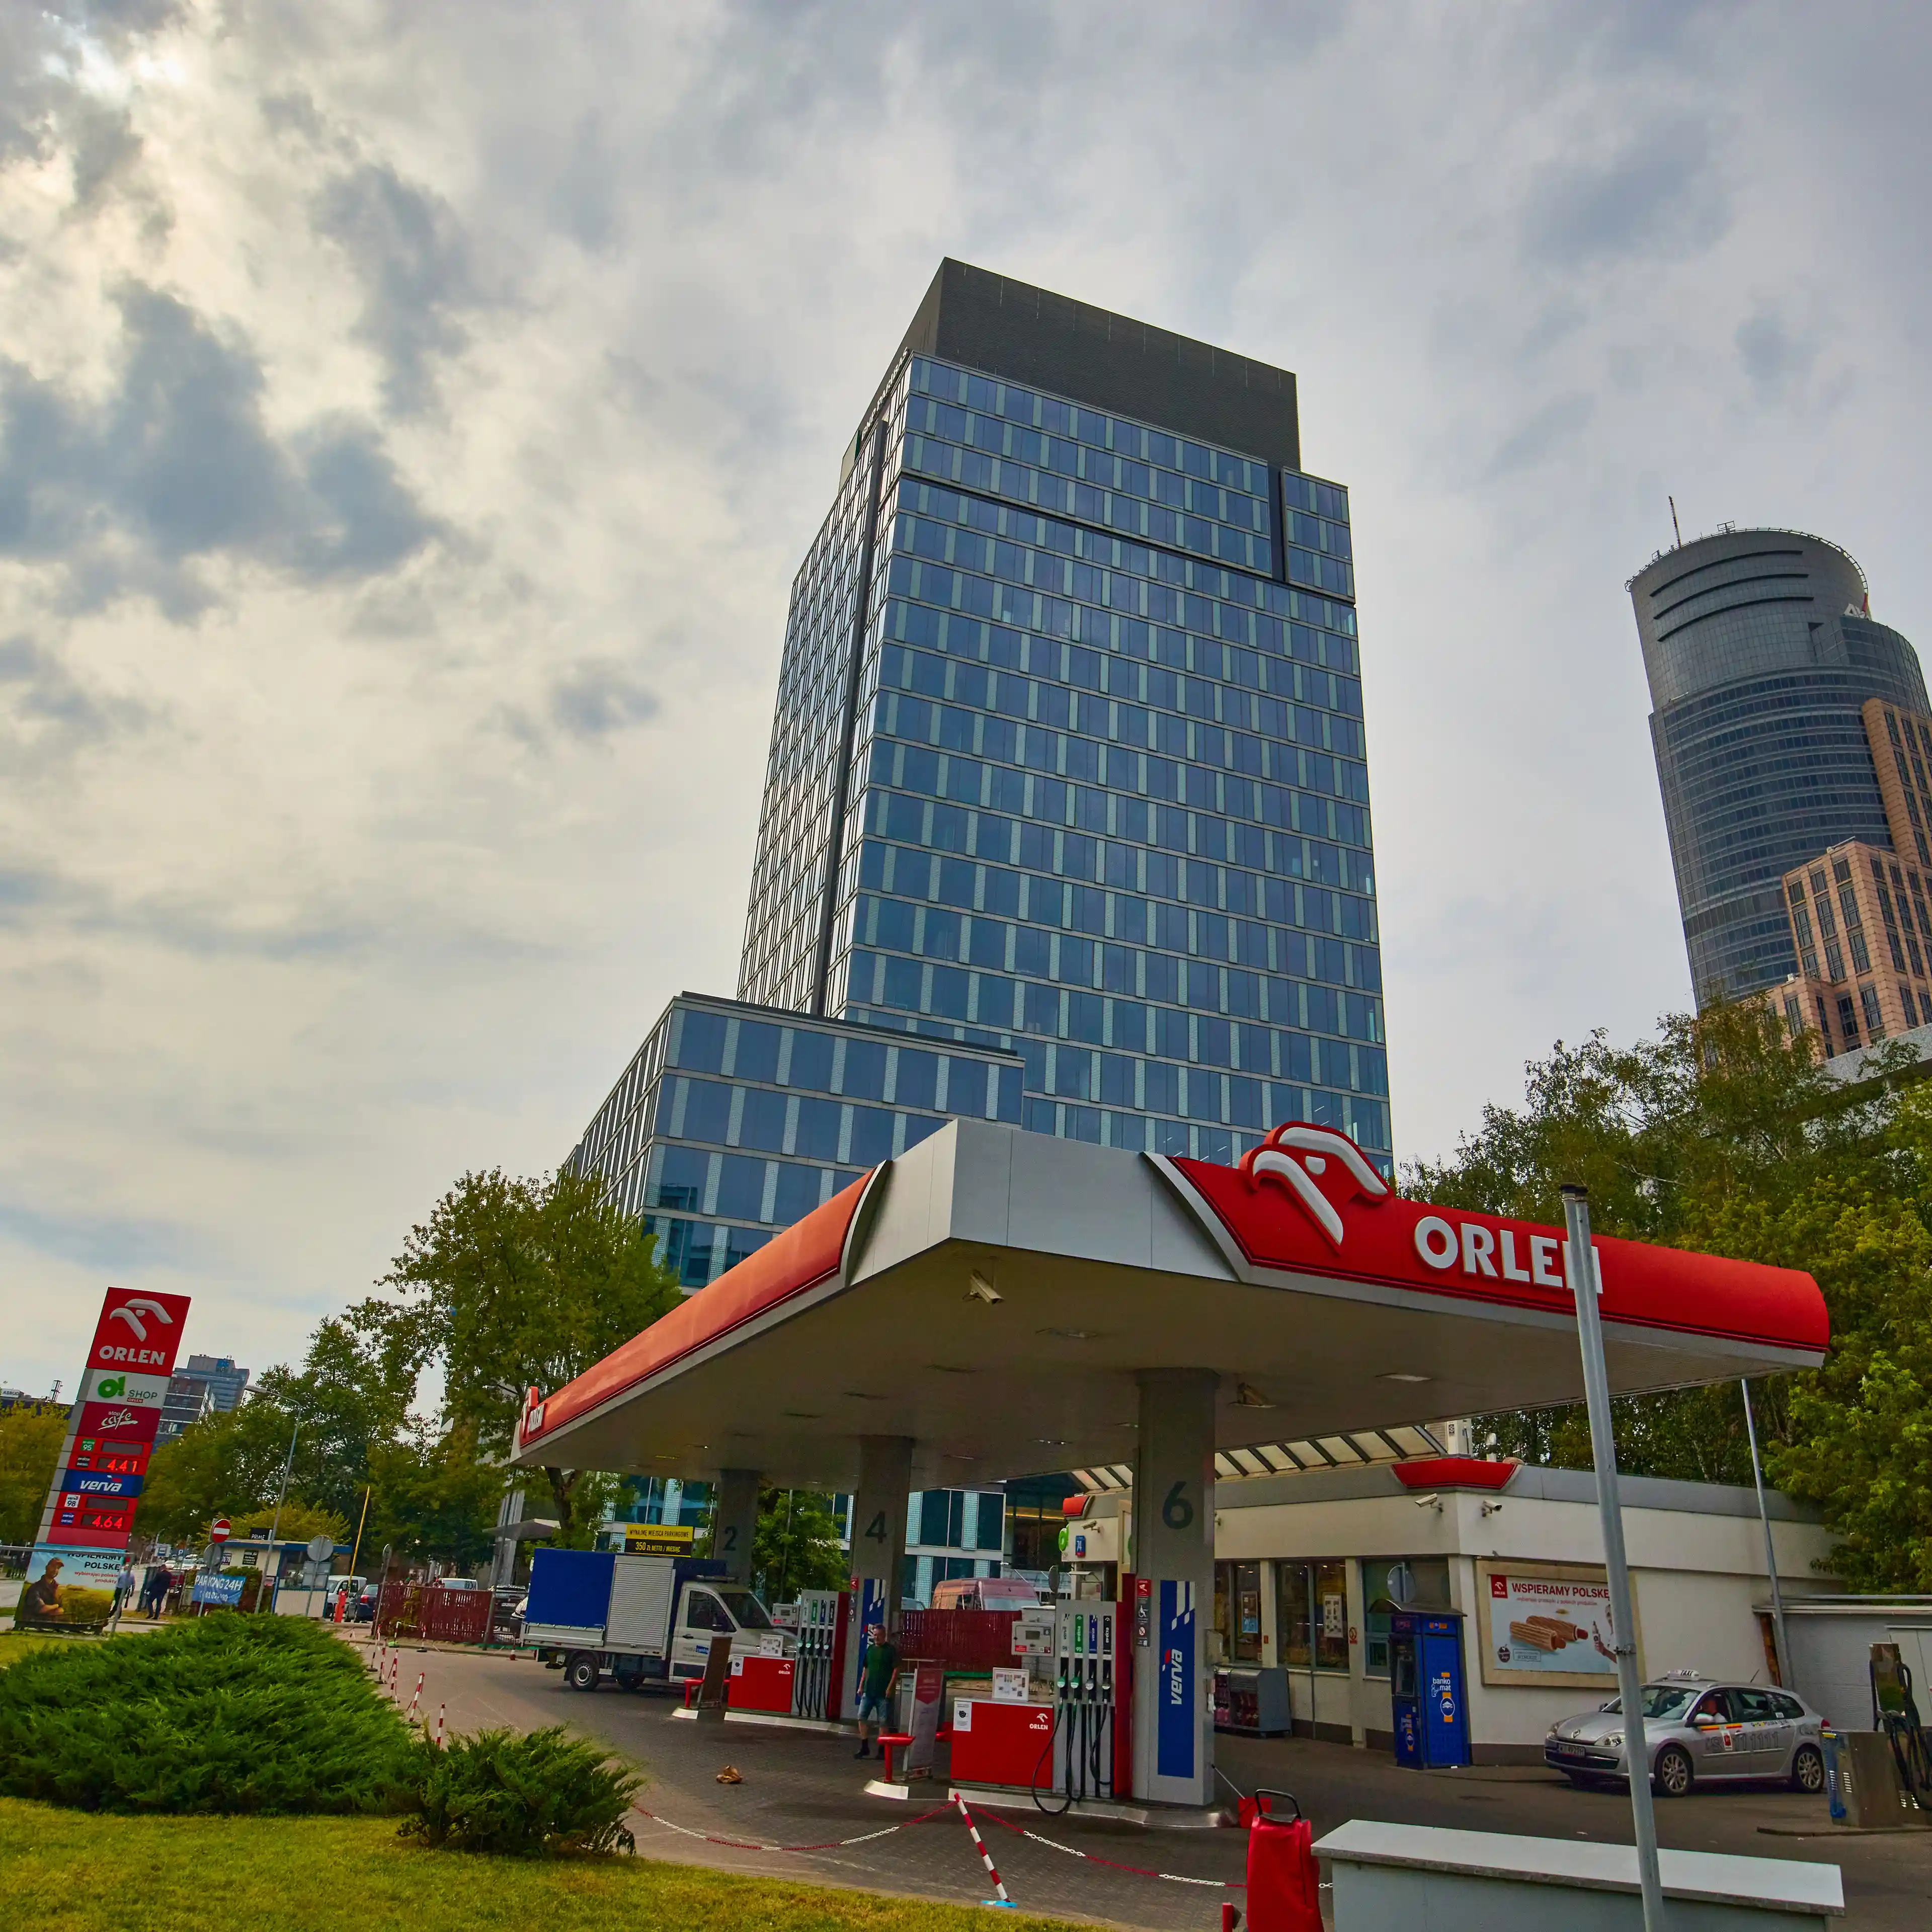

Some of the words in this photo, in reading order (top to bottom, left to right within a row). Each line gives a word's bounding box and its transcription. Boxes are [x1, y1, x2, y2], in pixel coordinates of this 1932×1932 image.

[99, 1345, 166, 1365] ORLEN
[128, 1390, 158, 1399] SHOP
[107, 1459, 137, 1473] 4.41
[79, 1480, 122, 1492] verva
[1162, 1481, 1194, 1530] 6
[92, 1515, 123, 1529] 4.64
[864, 1511, 888, 1544] 4
[722, 1526, 739, 1552] 2
[635, 1542, 647, 1551] 350
[84, 1561, 121, 1572] POLSKĘ
[224, 1579, 244, 1591] 24H
[1511, 1582, 1570, 1596] WSPIERAMY
[1171, 1649, 1183, 1705] verva
